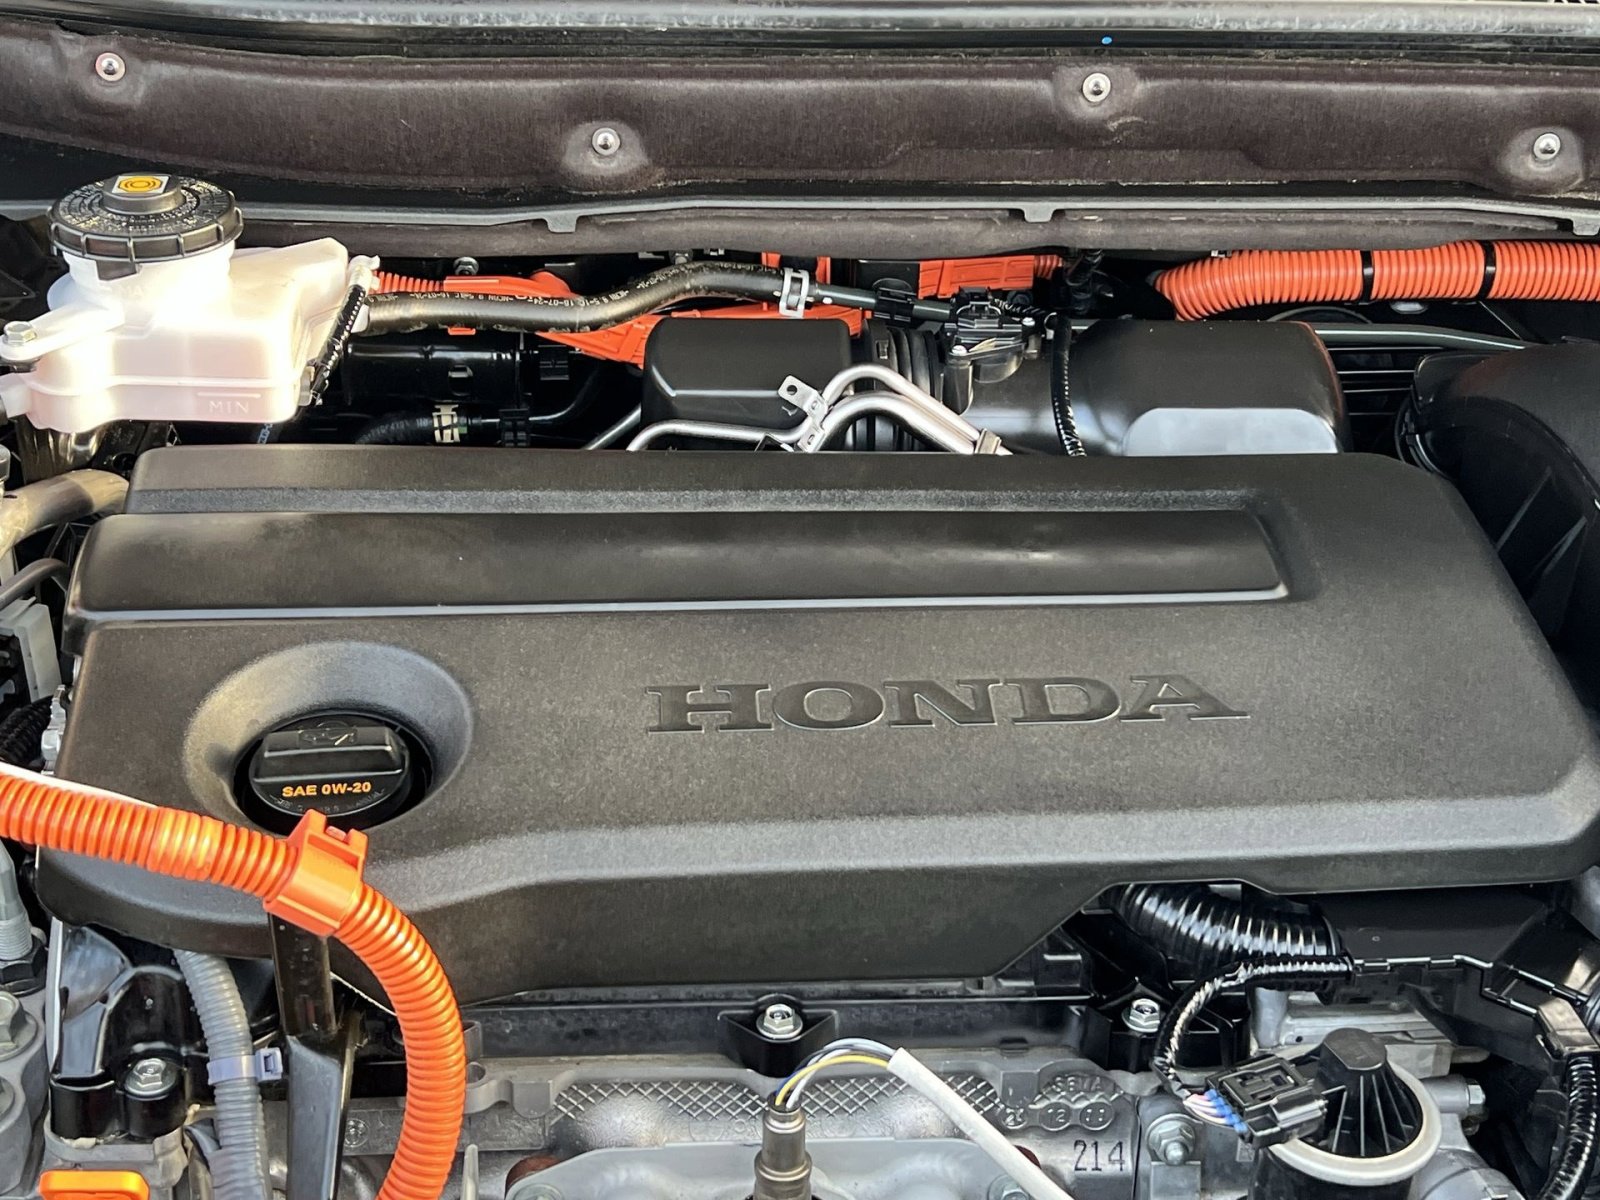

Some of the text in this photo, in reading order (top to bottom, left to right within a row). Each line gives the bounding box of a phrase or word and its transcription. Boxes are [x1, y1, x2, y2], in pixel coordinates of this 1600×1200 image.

[208, 400, 249, 414] MIN
[646, 673, 1251, 734] HONDA
[281, 781, 372, 797] SAE 0W-20
[1073, 1139, 1126, 1172] 214
